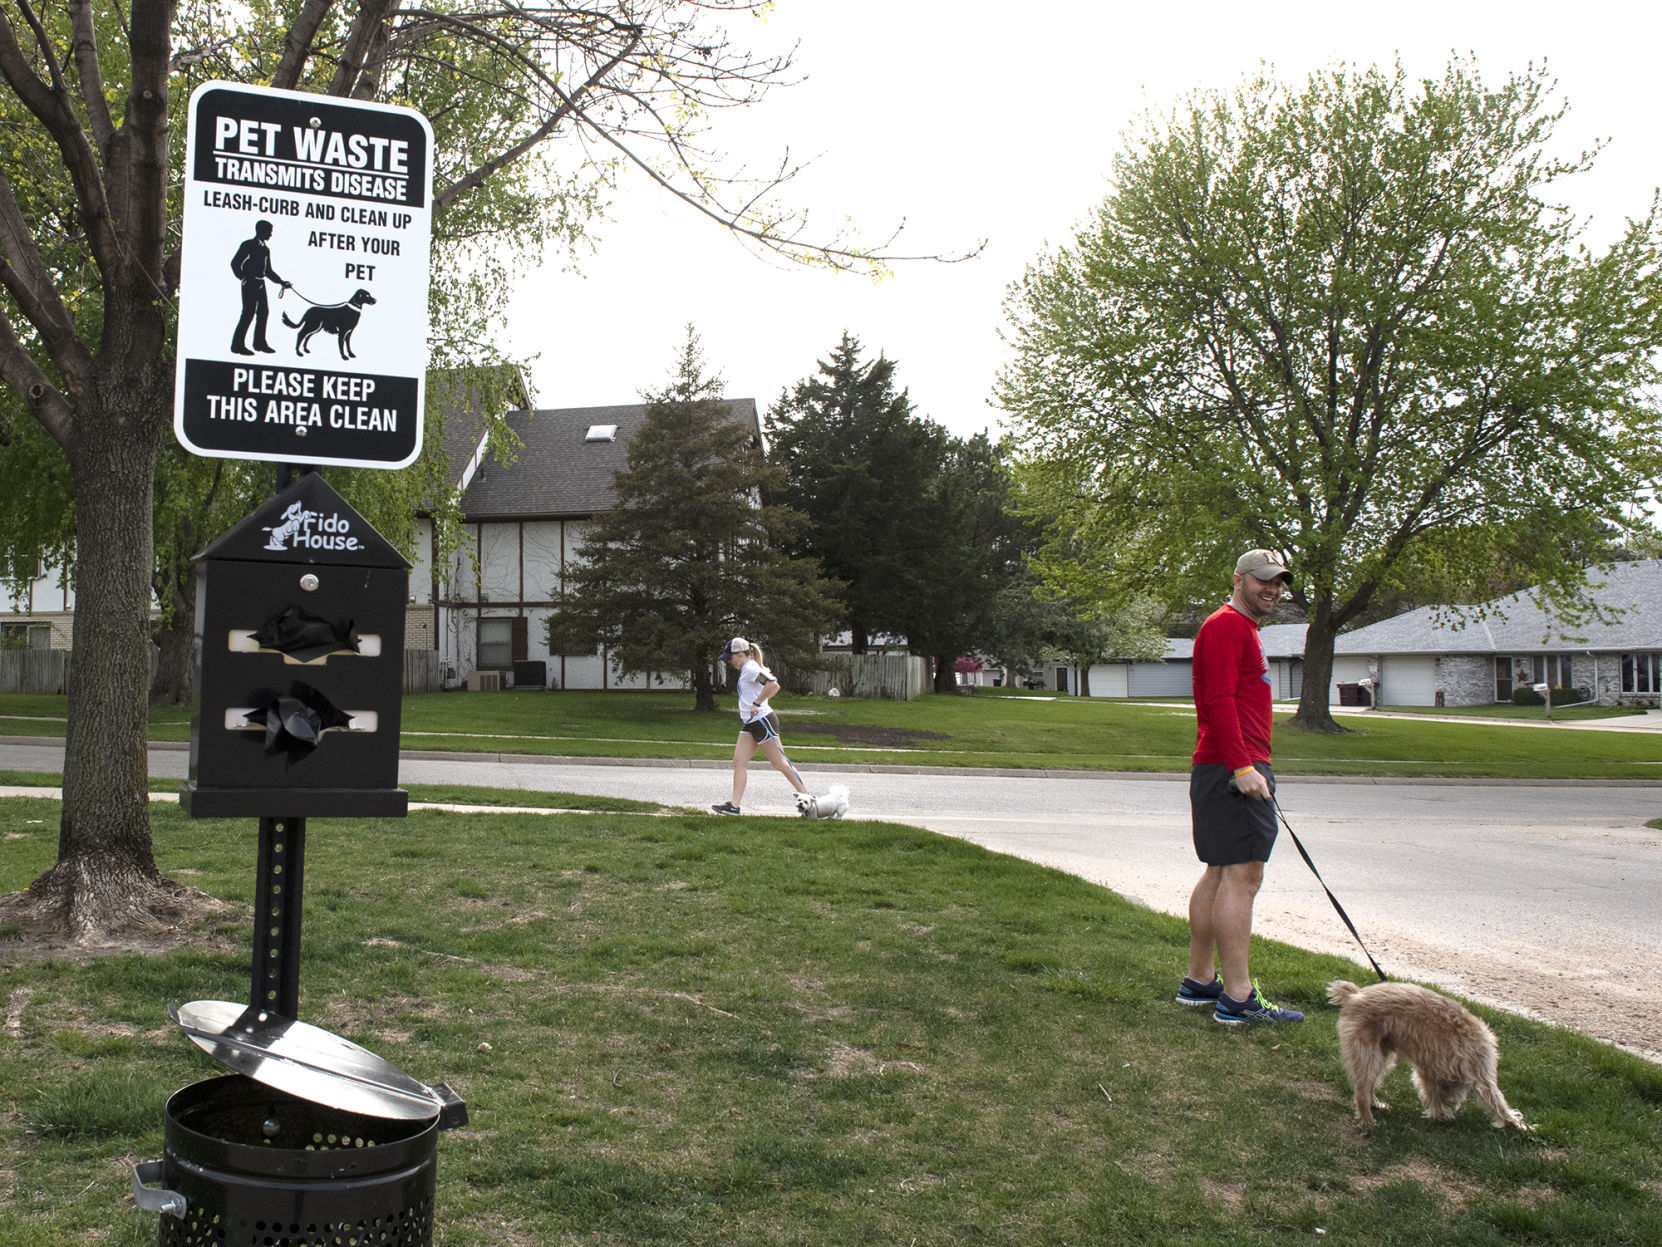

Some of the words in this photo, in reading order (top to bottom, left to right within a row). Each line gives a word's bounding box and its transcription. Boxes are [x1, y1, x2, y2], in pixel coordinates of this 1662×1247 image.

[215, 116, 281, 157] PET
[293, 126, 409, 174] WASTE
[215, 157, 325, 191] TRANSMITS
[331, 172, 407, 201] DISEASE
[203, 190, 299, 217] LEASH-CURB
[305, 202, 335, 221] AND
[341, 206, 387, 228] CLEAN
[392, 212, 412, 230] UP
[308, 231, 356, 252] AFTER
[361, 237, 401, 257] YOUR
[345, 262, 376, 282] PET
[233, 368, 315, 397] PLEASE
[322, 375, 376, 402] KEEP
[207, 395, 257, 422] THIS
[264, 400, 323, 427] AREA
[330, 404, 397, 432] CLEAN
[303, 511, 350, 534] Fido
[292, 529, 359, 551] House
